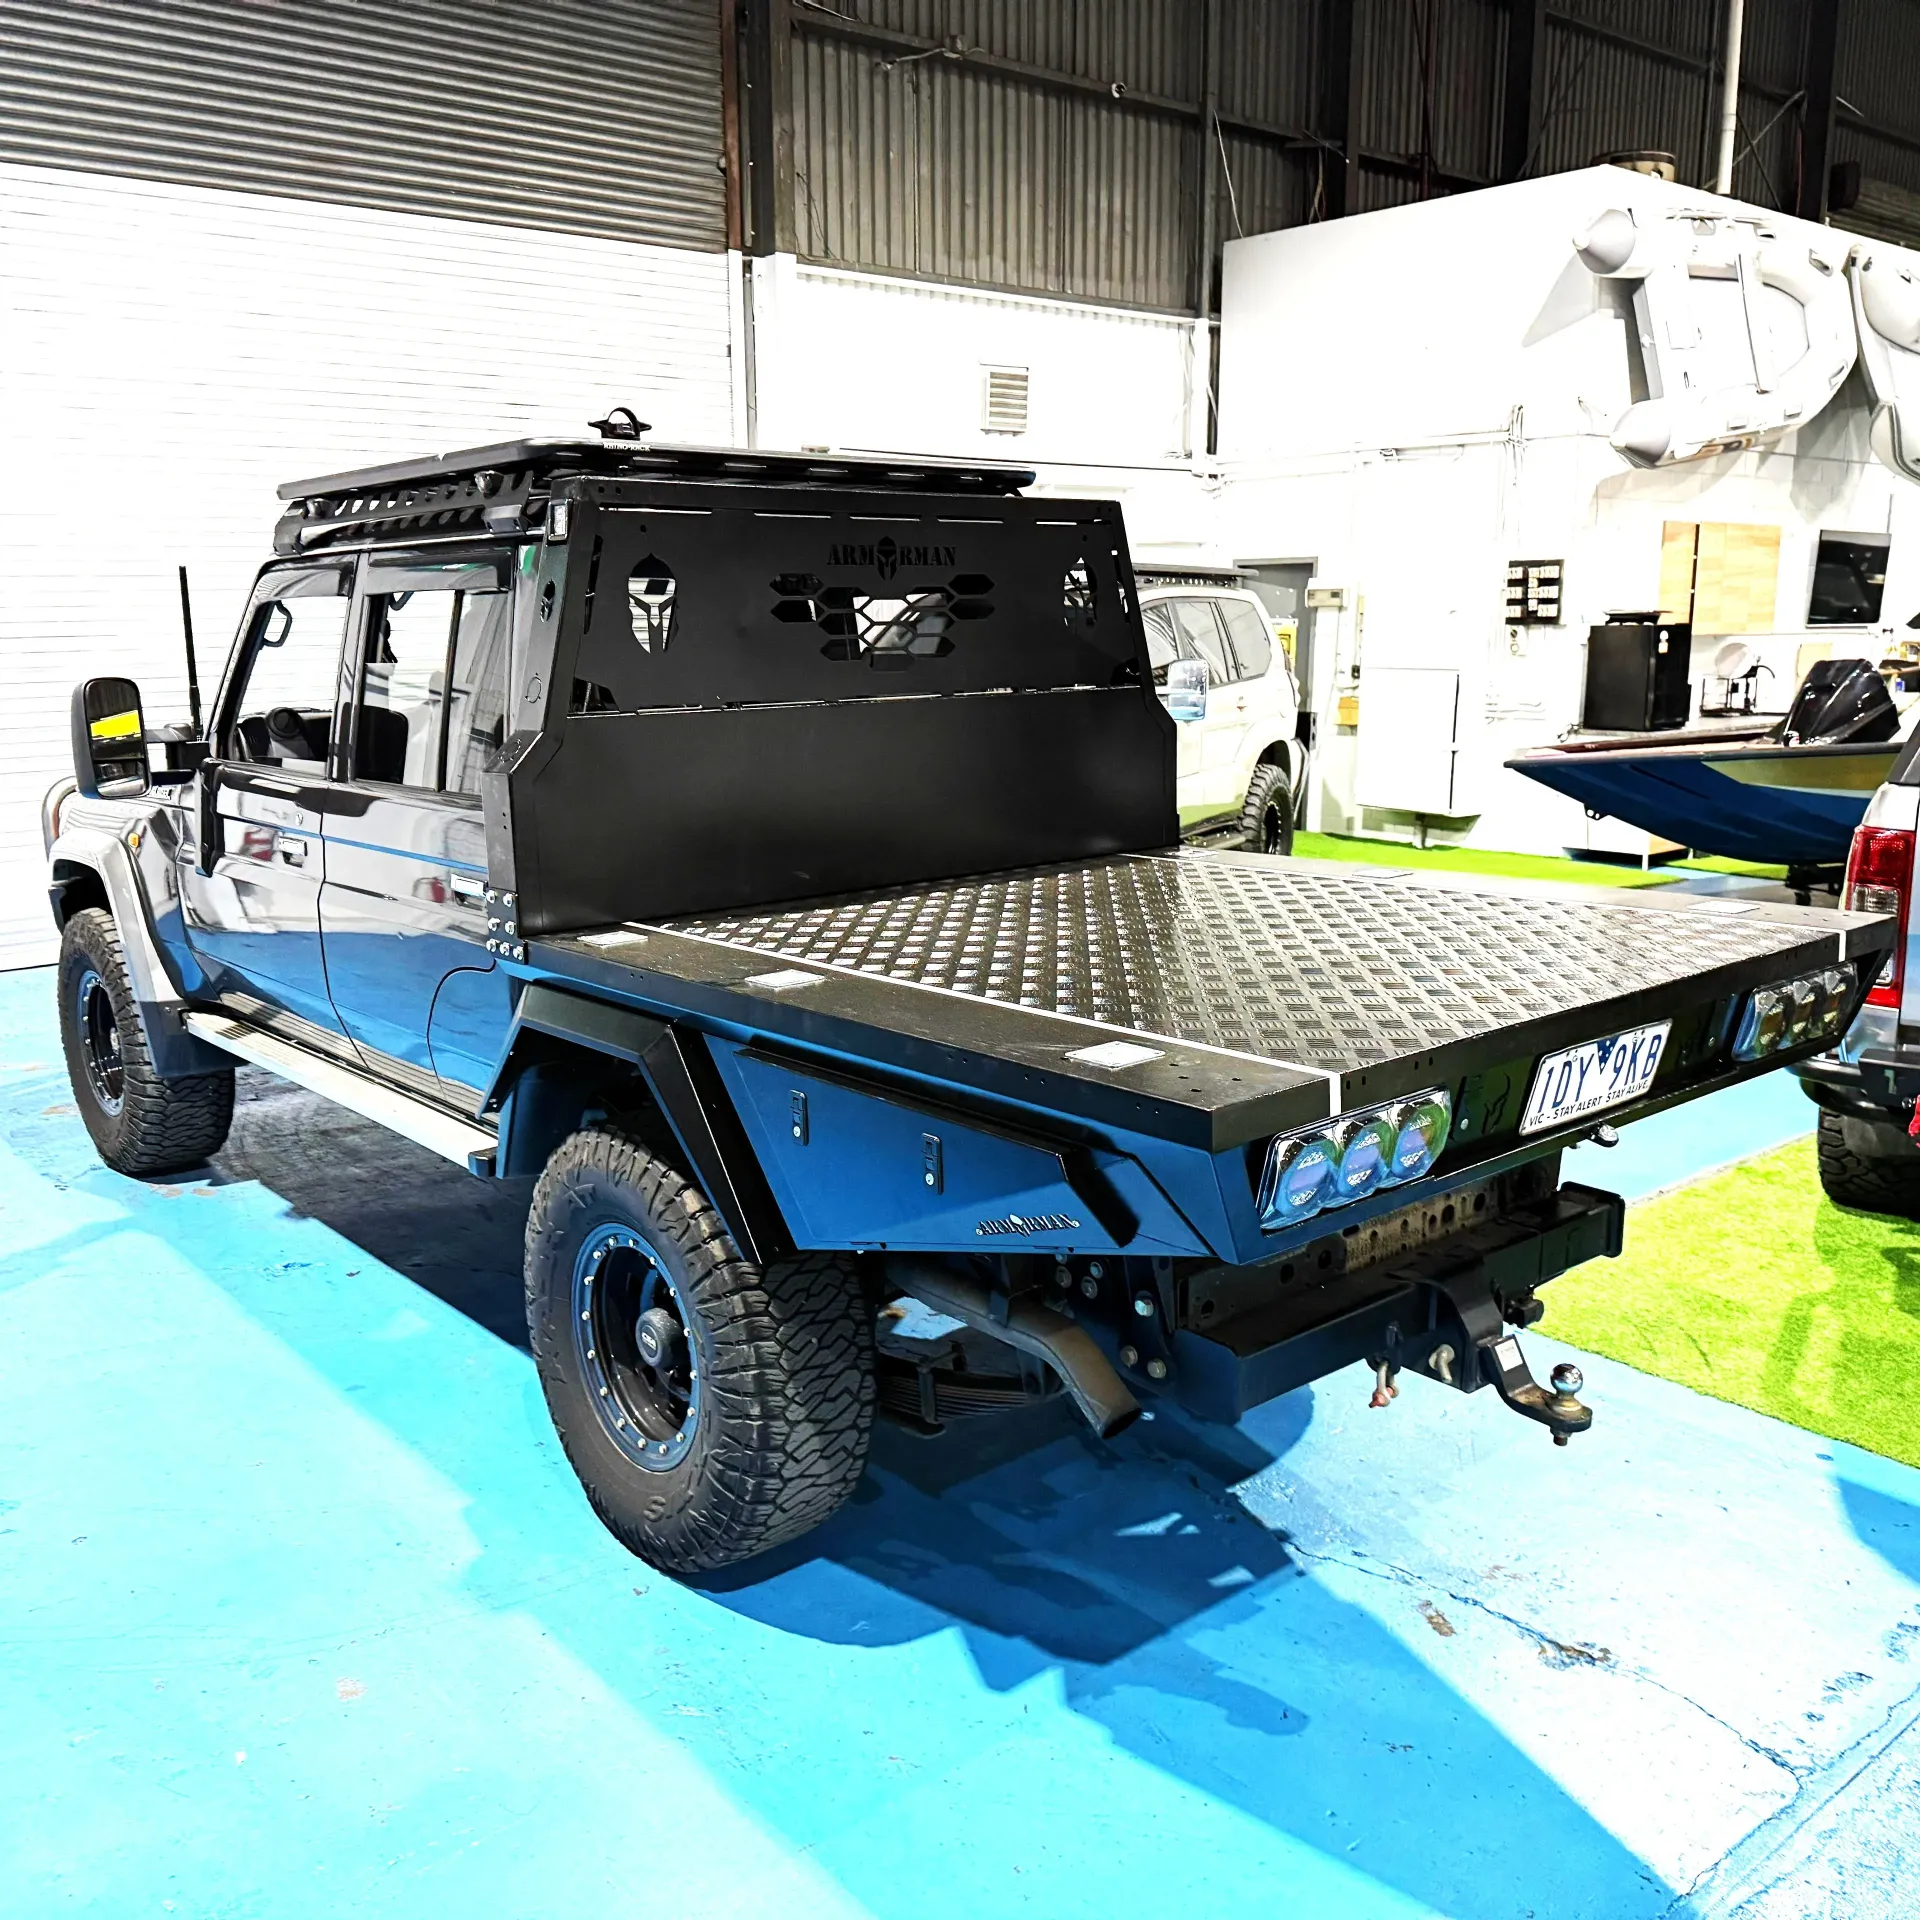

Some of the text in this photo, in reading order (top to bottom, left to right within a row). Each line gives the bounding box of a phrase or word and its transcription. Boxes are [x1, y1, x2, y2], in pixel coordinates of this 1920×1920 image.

[1537, 1034, 1662, 1114] 1DY 9KB
[1529, 1113, 1545, 1127] VIC
[1552, 1104, 1576, 1120] STAY
[1575, 1095, 1602, 1113] ALERT
[1605, 1090, 1625, 1104] STAY
